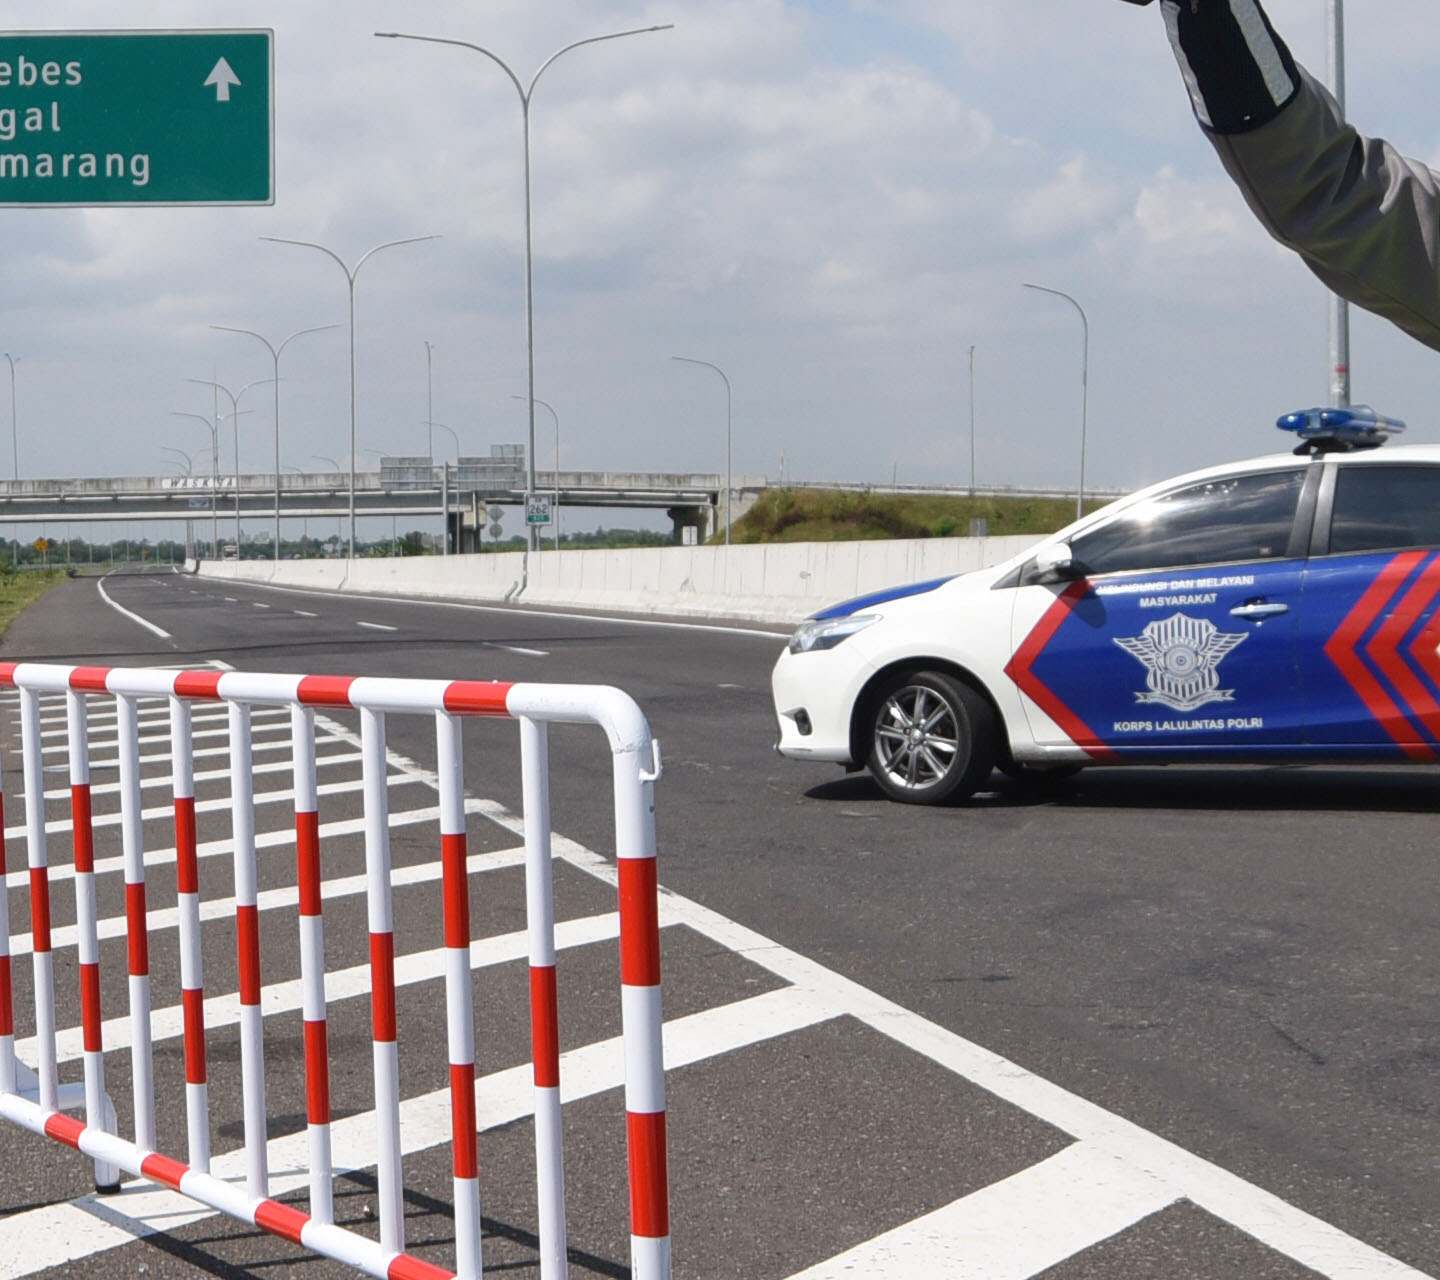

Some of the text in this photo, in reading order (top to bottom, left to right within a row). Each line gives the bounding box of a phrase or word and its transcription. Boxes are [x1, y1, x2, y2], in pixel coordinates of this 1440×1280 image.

[1170, 579, 1195, 590] DAN
[1197, 575, 1255, 589] MELAYANI
[1139, 593, 1218, 608] MASYARAKAT
[1114, 718, 1262, 731] KORPS LALULINTAS POLRI
